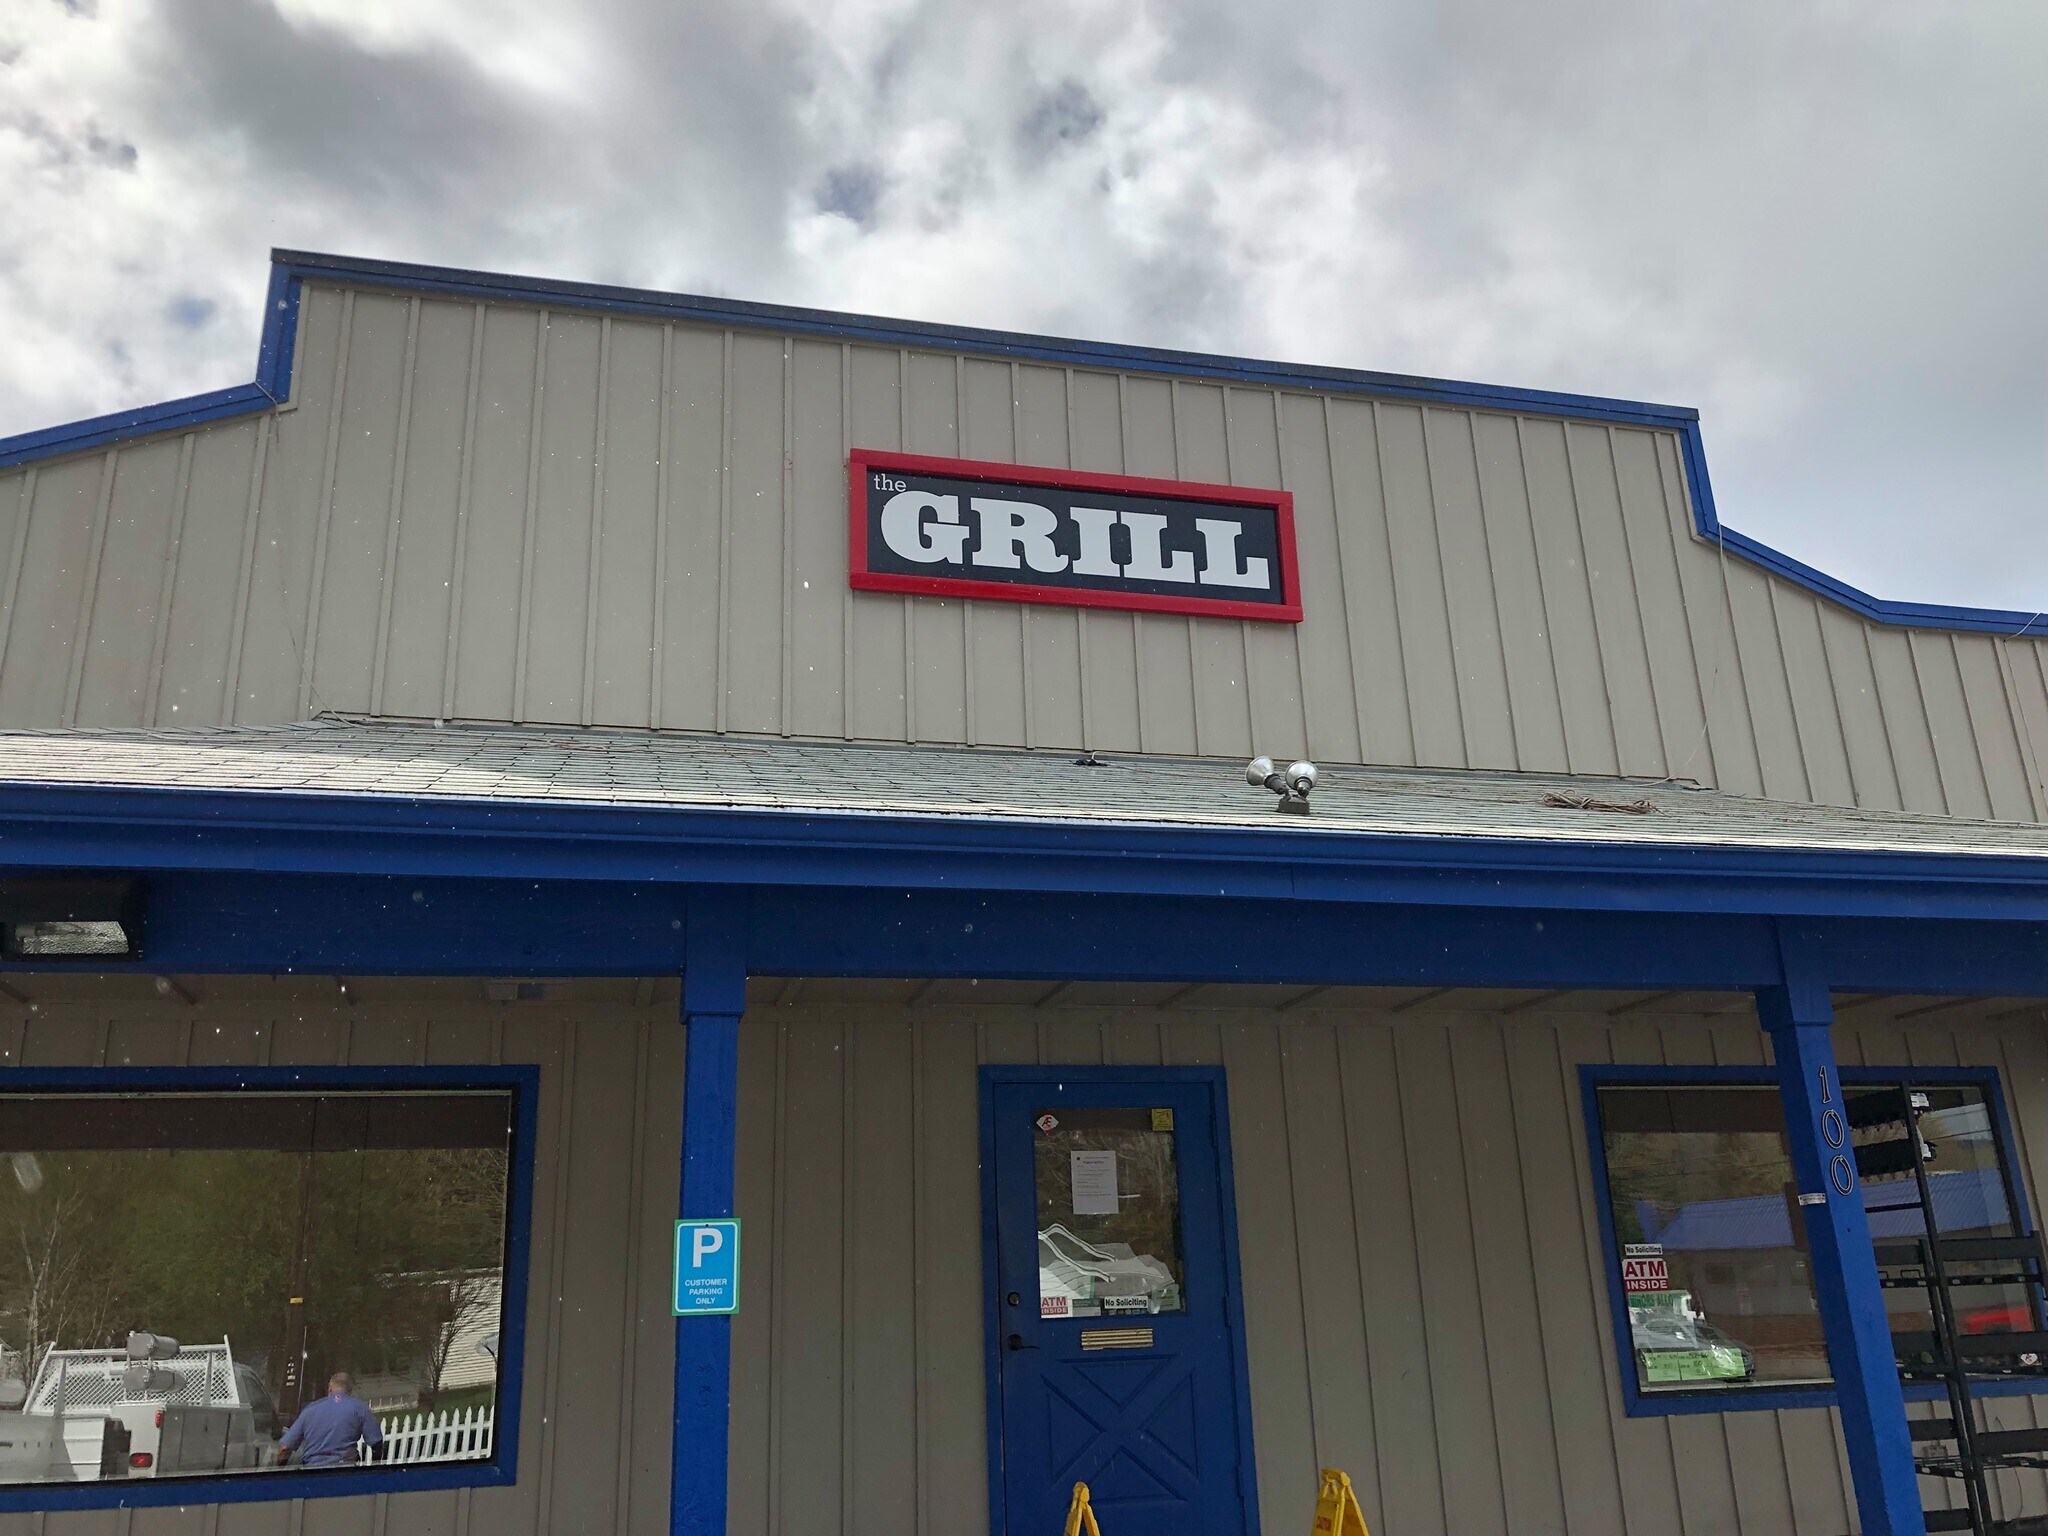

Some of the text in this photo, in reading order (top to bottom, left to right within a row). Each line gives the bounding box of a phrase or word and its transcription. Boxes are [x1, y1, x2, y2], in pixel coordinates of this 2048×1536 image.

[873, 473, 907, 492] the
[880, 490, 1270, 590] GRILL
[1819, 1065, 1854, 1195] 100
[693, 1228, 723, 1268] P
[1626, 1245, 1662, 1255] No Soliciting
[1625, 1260, 1666, 1278] ATM
[684, 1279, 728, 1287] CUSTOMER
[1626, 1280, 1668, 1290] INSIDE
[689, 1288, 723, 1296] PARKING
[695, 1297, 716, 1305] ONLY
[1041, 1296, 1067, 1307] ATM
[1105, 1298, 1114, 1307] No
[1116, 1298, 1147, 1308] Soliciting
[1041, 1307, 1068, 1315] INSIDE
